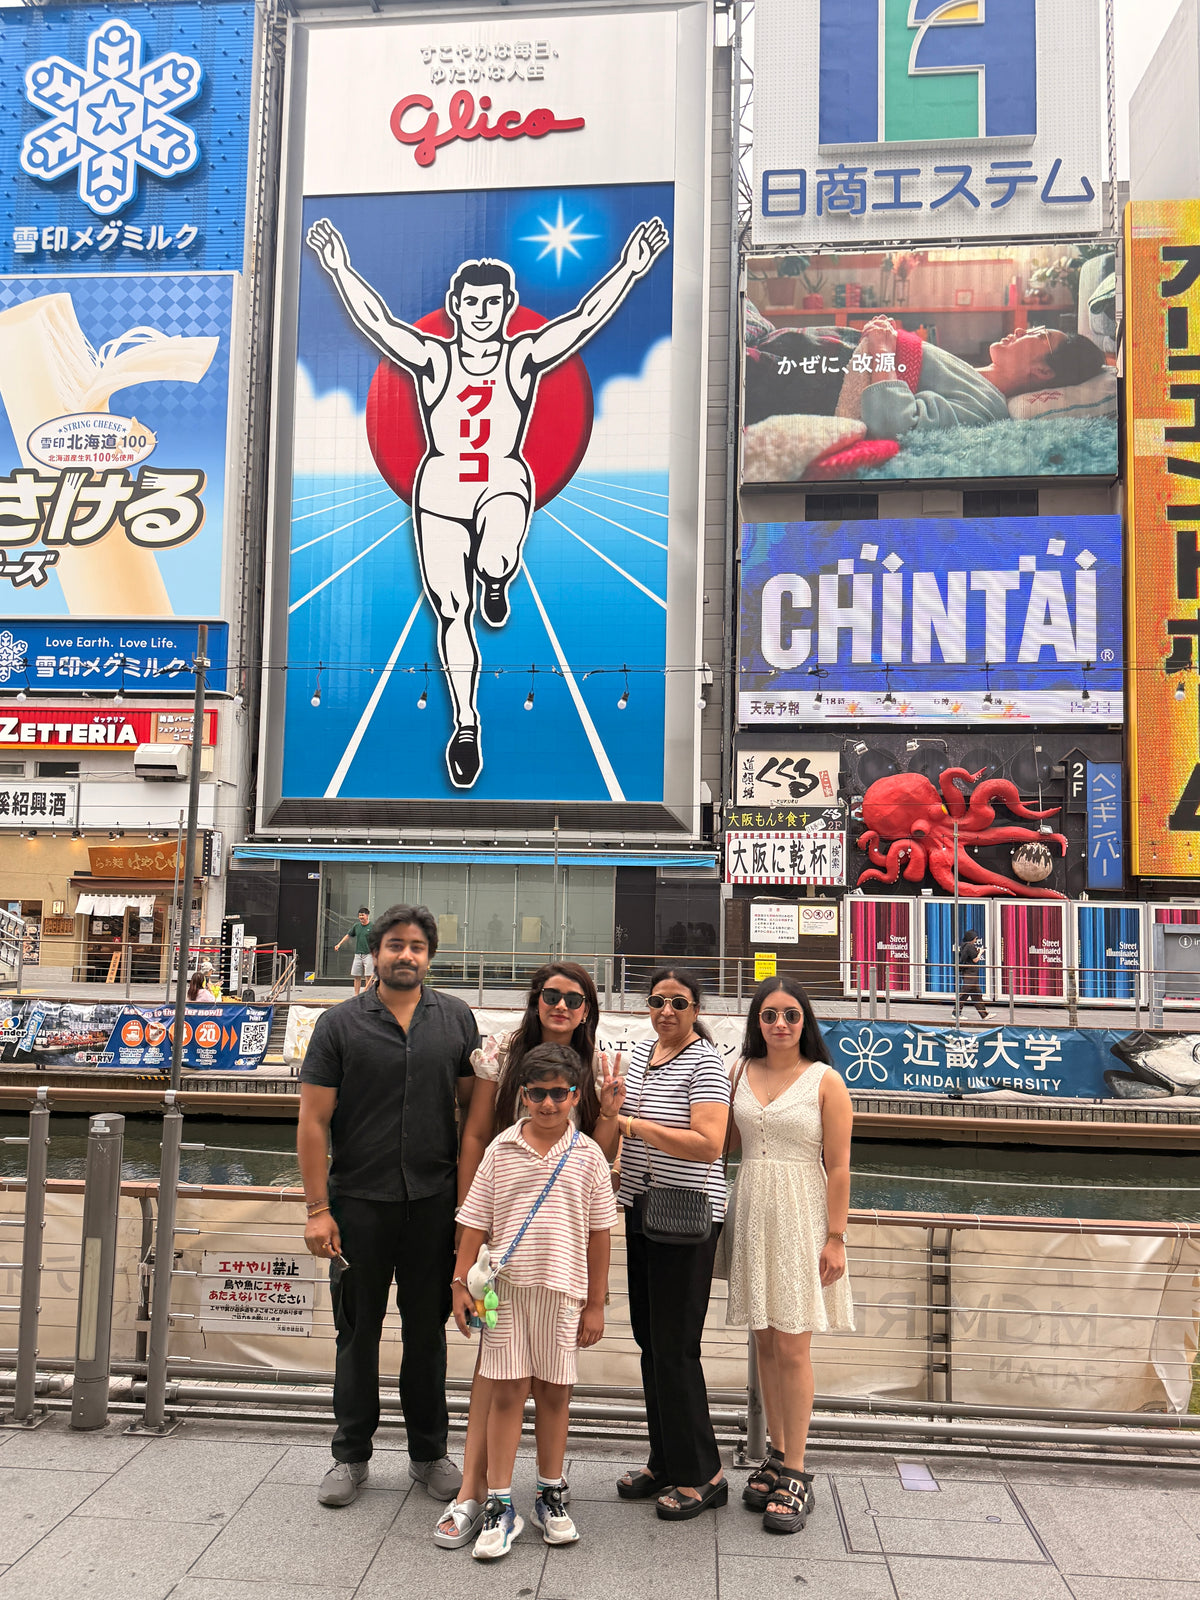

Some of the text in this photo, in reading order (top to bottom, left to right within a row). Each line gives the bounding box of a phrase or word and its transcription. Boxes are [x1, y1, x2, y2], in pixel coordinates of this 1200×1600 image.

[420, 40, 559, 63] すこやかな毎日、
[430, 62, 546, 84] ゆたかな人生
[762, 158, 1095, 218] 日商エステム
[13, 220, 199, 253] 雪印メグミルク
[777, 352, 907, 375] かぜに、改源。
[62, 419, 122, 433] STRING CHEESE
[456, 380, 496, 482] グリコ
[41, 434, 147, 450] 雪印北海道 100
[48, 452, 134, 462] 北海道産生乳100%使用
[0, 551, 56, 585] ーズ
[760, 539, 1098, 670] CHINTAI
[46, 637, 177, 648] Love Earth. Love Life.
[36, 652, 186, 678] 雪印メグミルク
[750, 701, 800, 716] 天気予報
[0, 717, 138, 744] ZETTERIA
[756, 757, 819, 798] くくる
[728, 811, 811, 828] 大阪もんを食す
[827, 821, 842, 830] 2F
[1092, 773, 1117, 876] ペンギンバー
[732, 840, 828, 876] 大阪に乾杯
[889, 934, 907, 943] Street
[1042, 938, 1060, 947] Street
[1119, 941, 1137, 950] Street
[86, 1055, 113, 1063] PARTY
[903, 1029, 1063, 1071] 近畿大学
[903, 1073, 1062, 1091] KINDAI UNIVERSITY
[218, 1261, 300, 1276] エサやり禁止
[224, 1279, 293, 1293] 鳥や魚にエサを
[208, 1290, 306, 1305] あたえないでください
